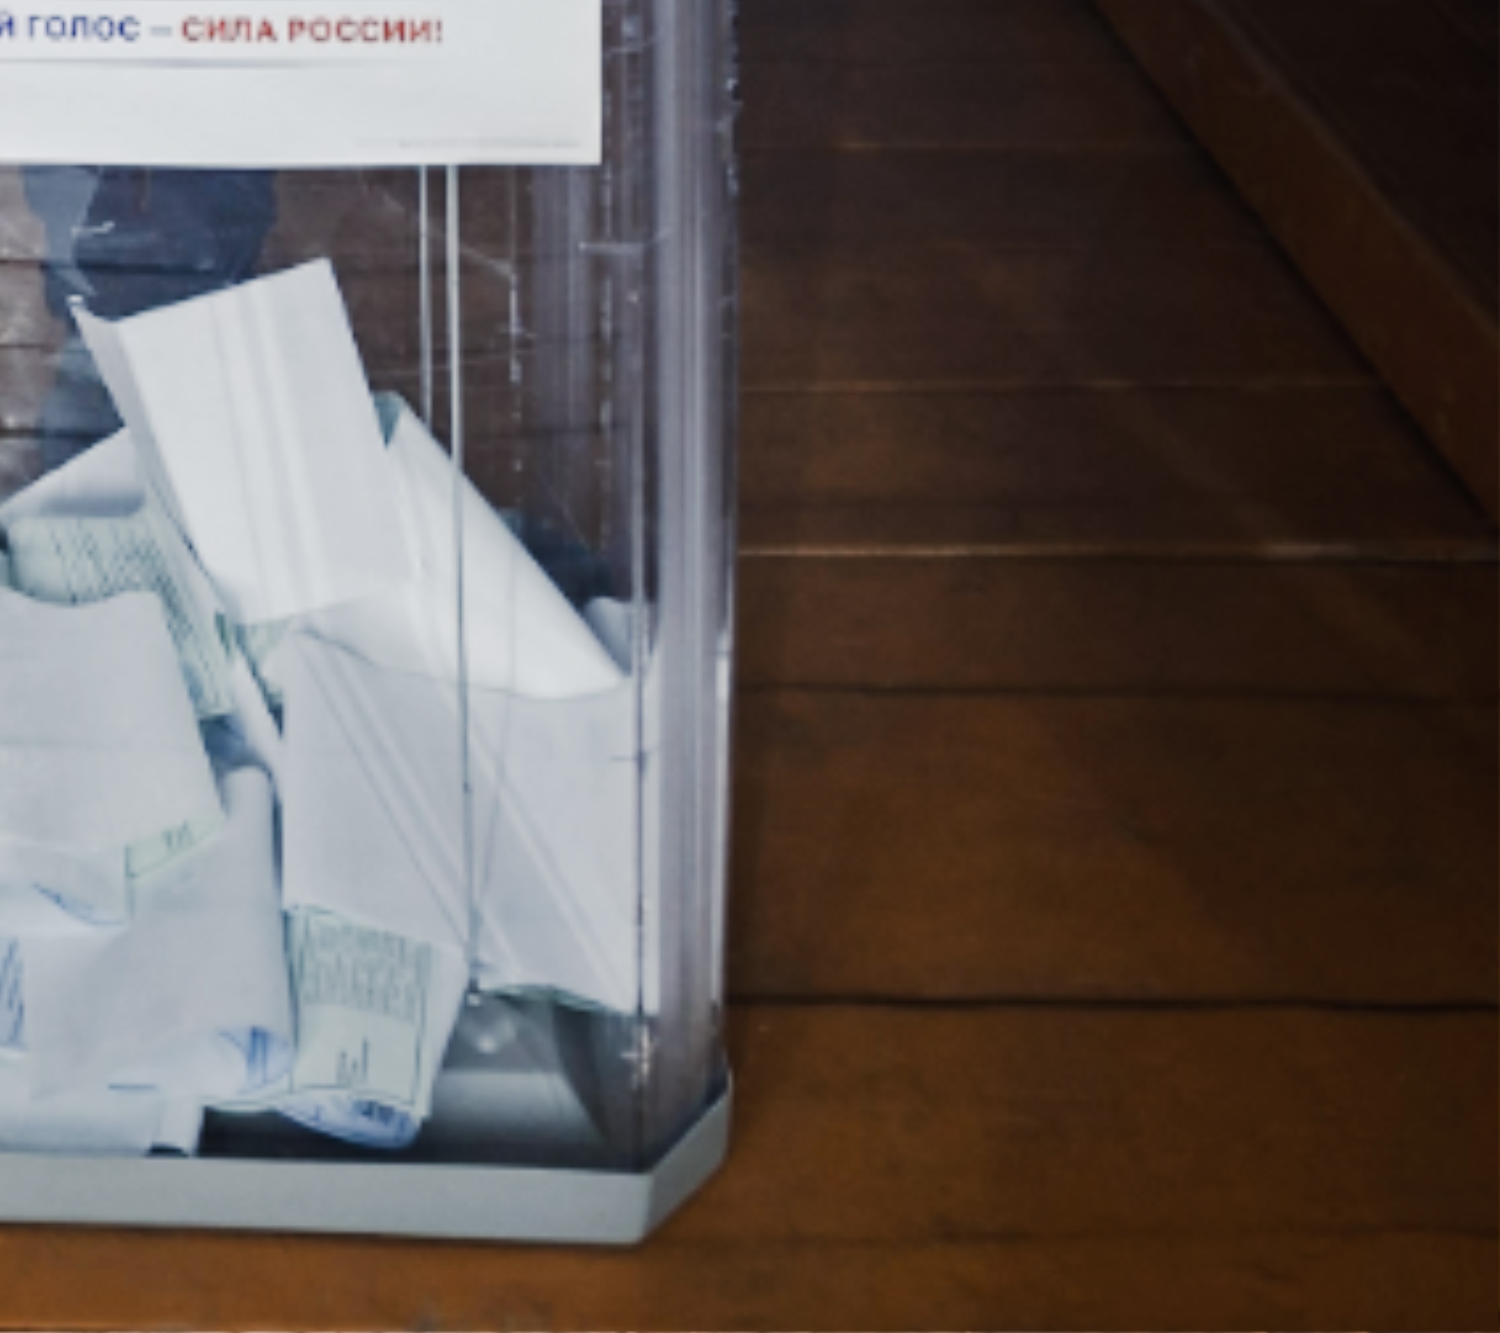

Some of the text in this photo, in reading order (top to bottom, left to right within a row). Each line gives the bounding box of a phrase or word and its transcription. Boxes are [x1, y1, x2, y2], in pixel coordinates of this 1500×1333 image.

[29, 14, 140, 42] ГОЛОС
[181, 16, 277, 44] СИЛА
[289, 18, 443, 44] РОССИИ!
